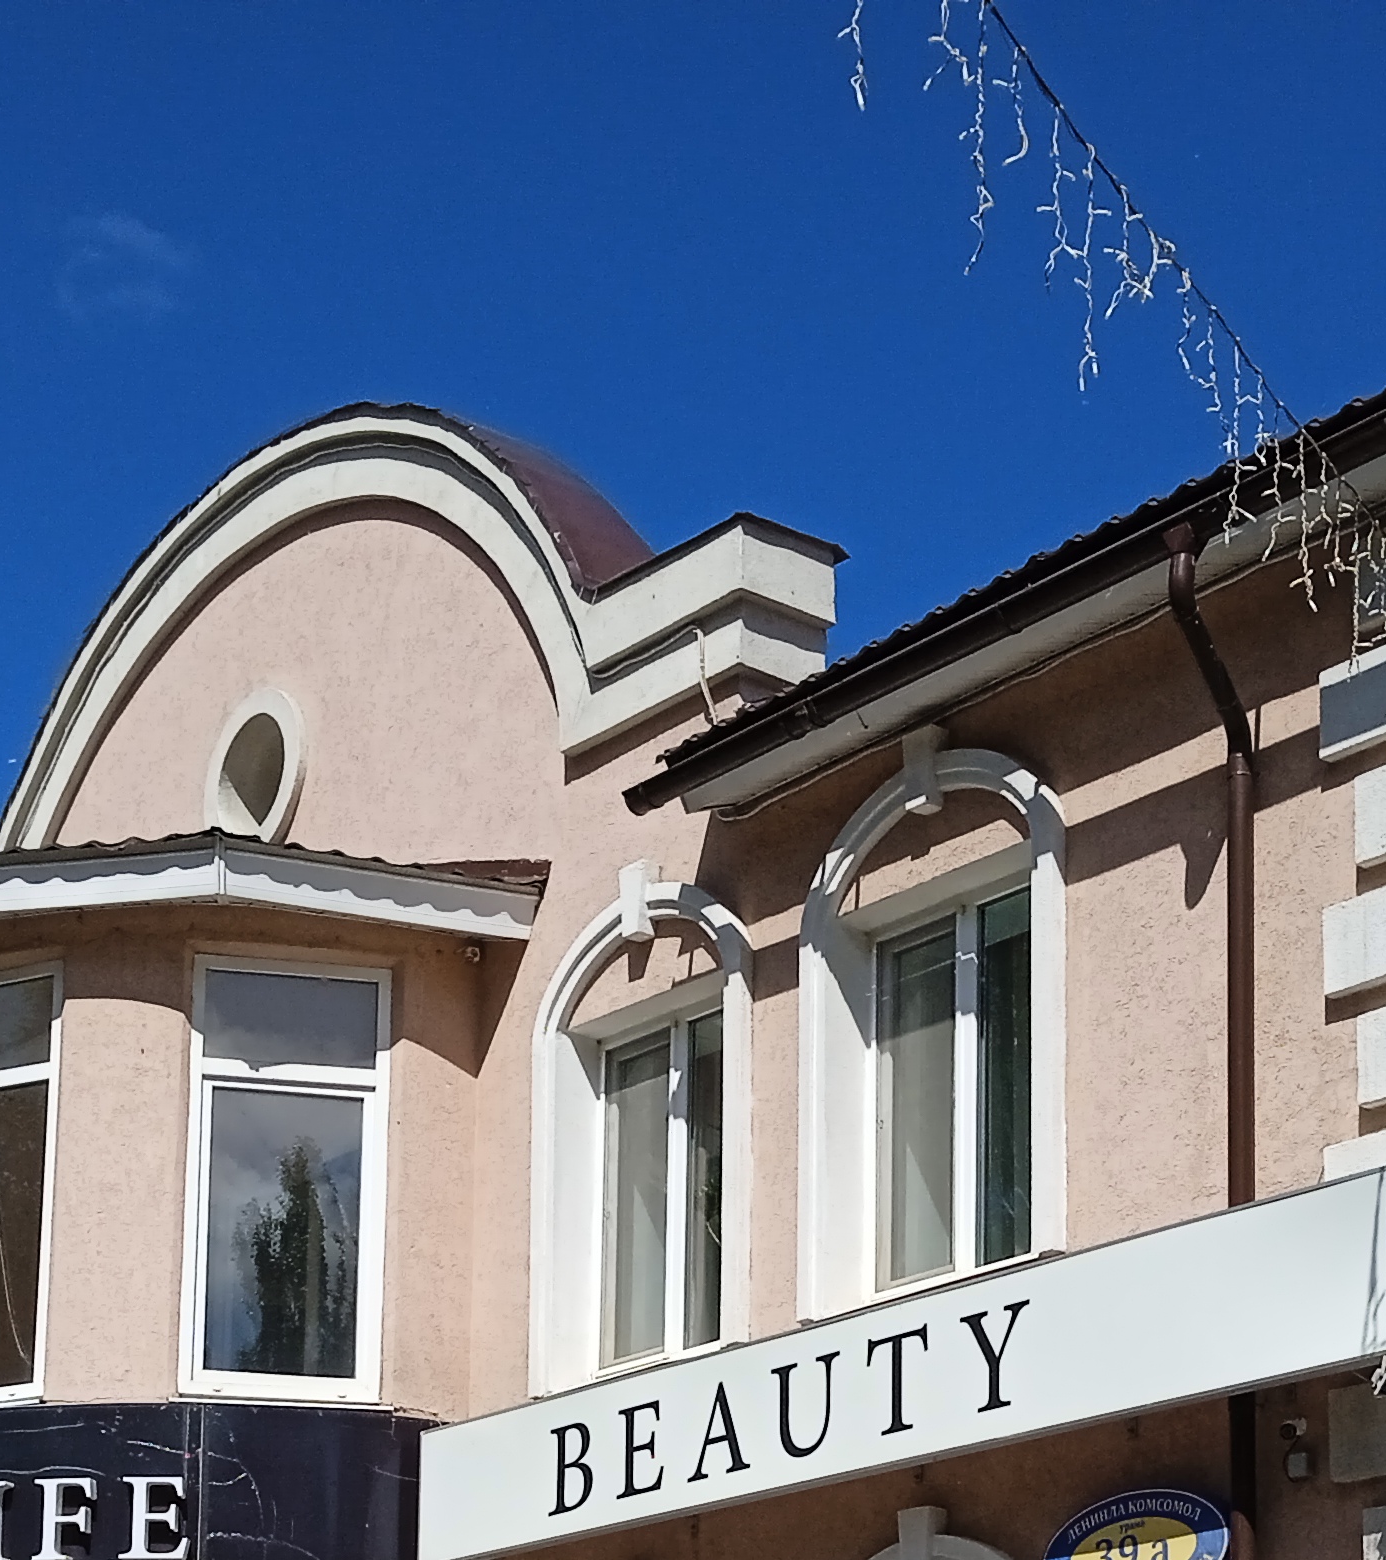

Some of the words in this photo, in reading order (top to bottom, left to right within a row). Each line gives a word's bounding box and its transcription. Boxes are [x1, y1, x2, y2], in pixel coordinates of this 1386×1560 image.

[547, 1299, 1031, 1518] BEAUTY
[1067, 1501, 1126, 1545] ЛЕНИНЛА
[1128, 1498, 1201, 1522] КОМСОМОЛ
